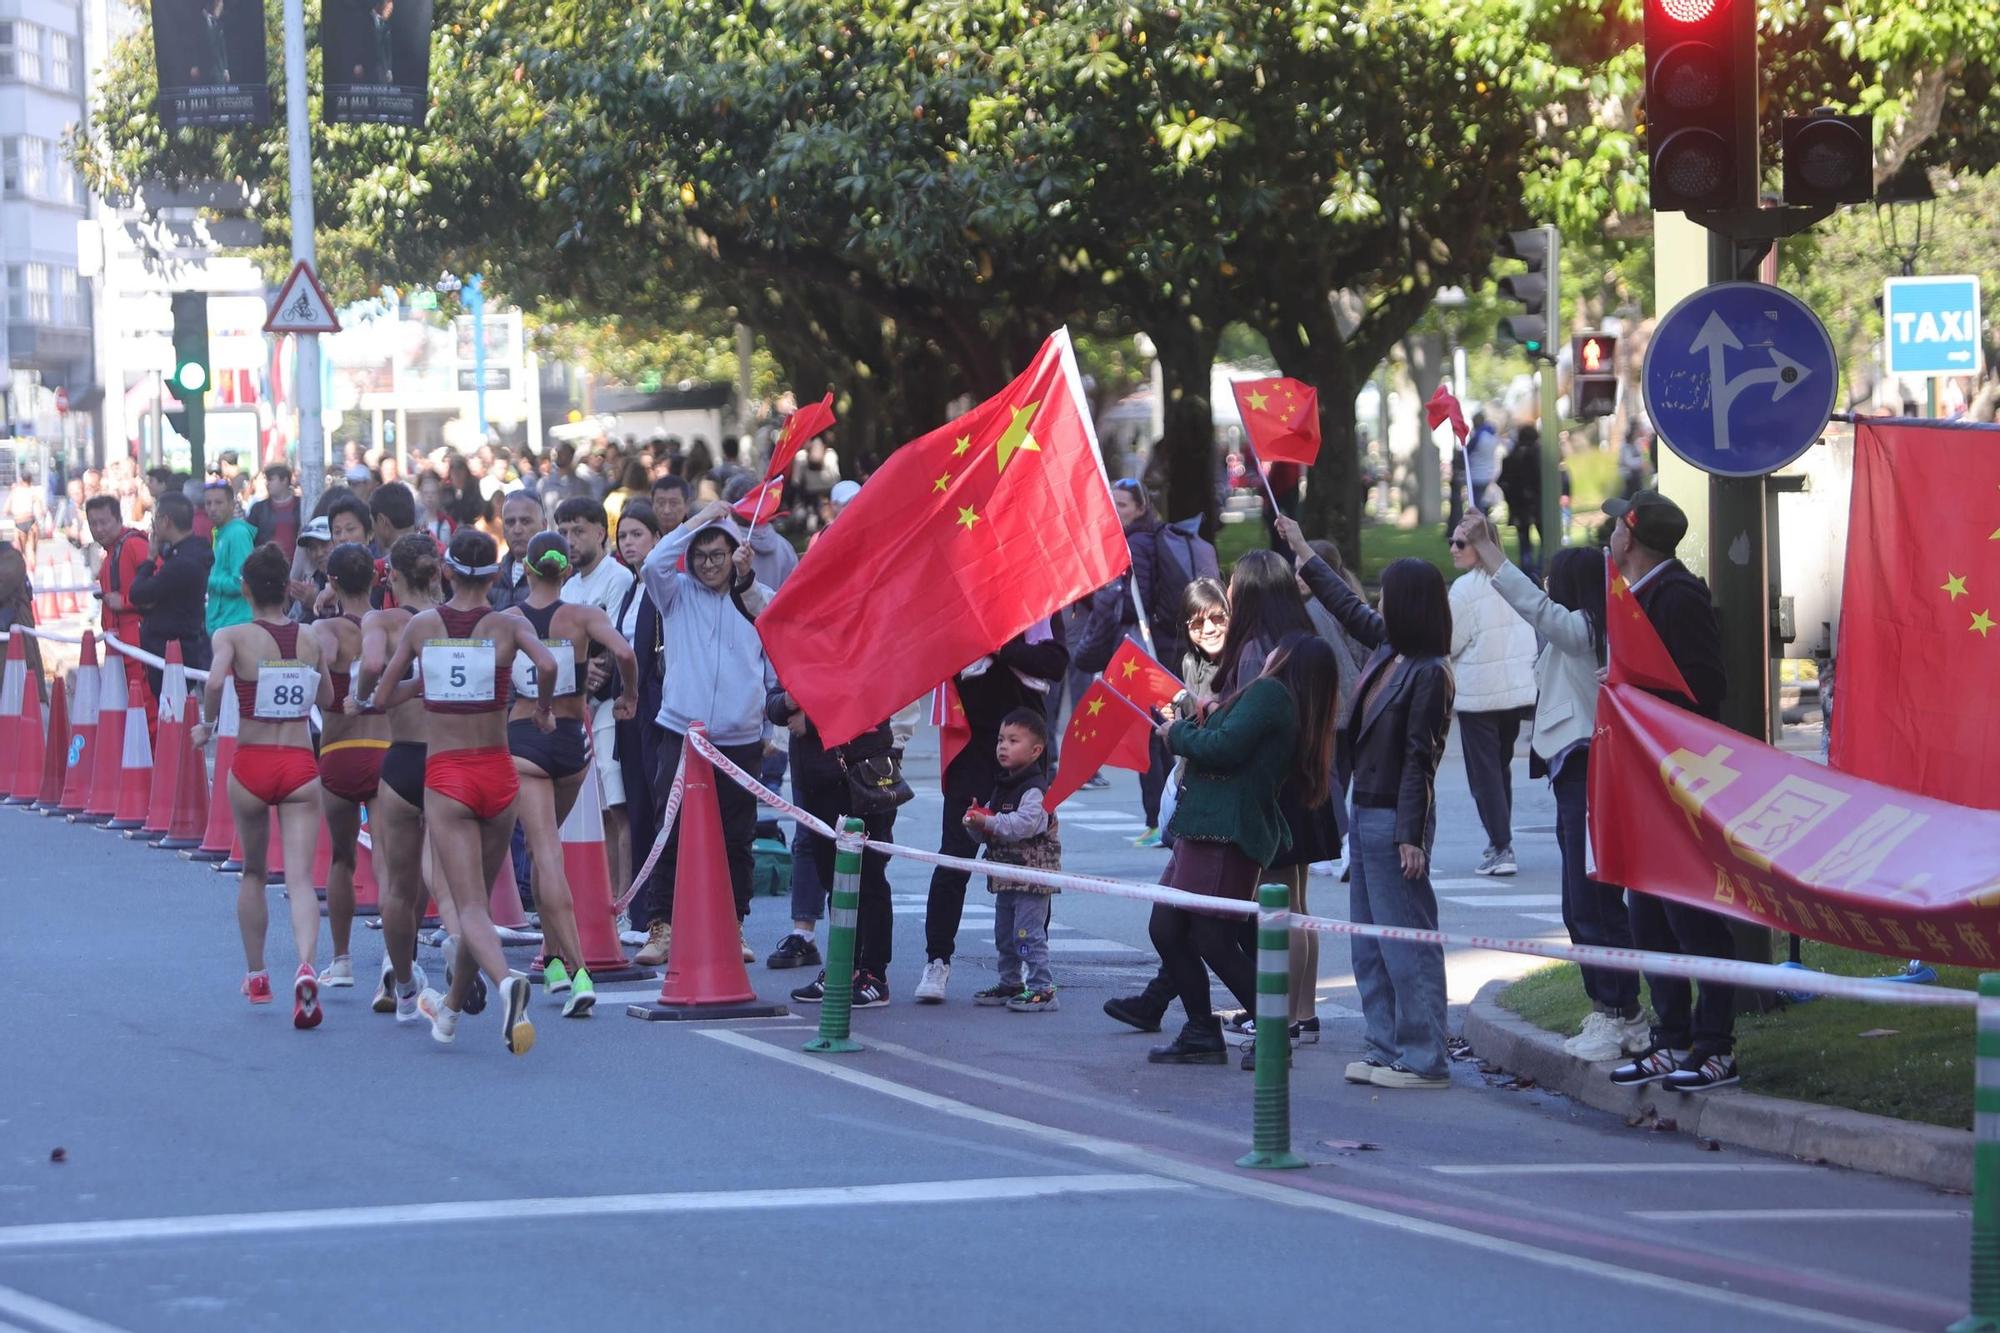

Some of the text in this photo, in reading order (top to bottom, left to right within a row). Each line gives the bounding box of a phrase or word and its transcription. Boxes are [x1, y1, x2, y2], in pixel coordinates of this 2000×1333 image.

[1893, 310, 1973, 344] TAXI
[450, 666, 466, 687] 5
[273, 685, 304, 705] 88
[1713, 861, 2000, 961] 西班牙加利西亚华侨
